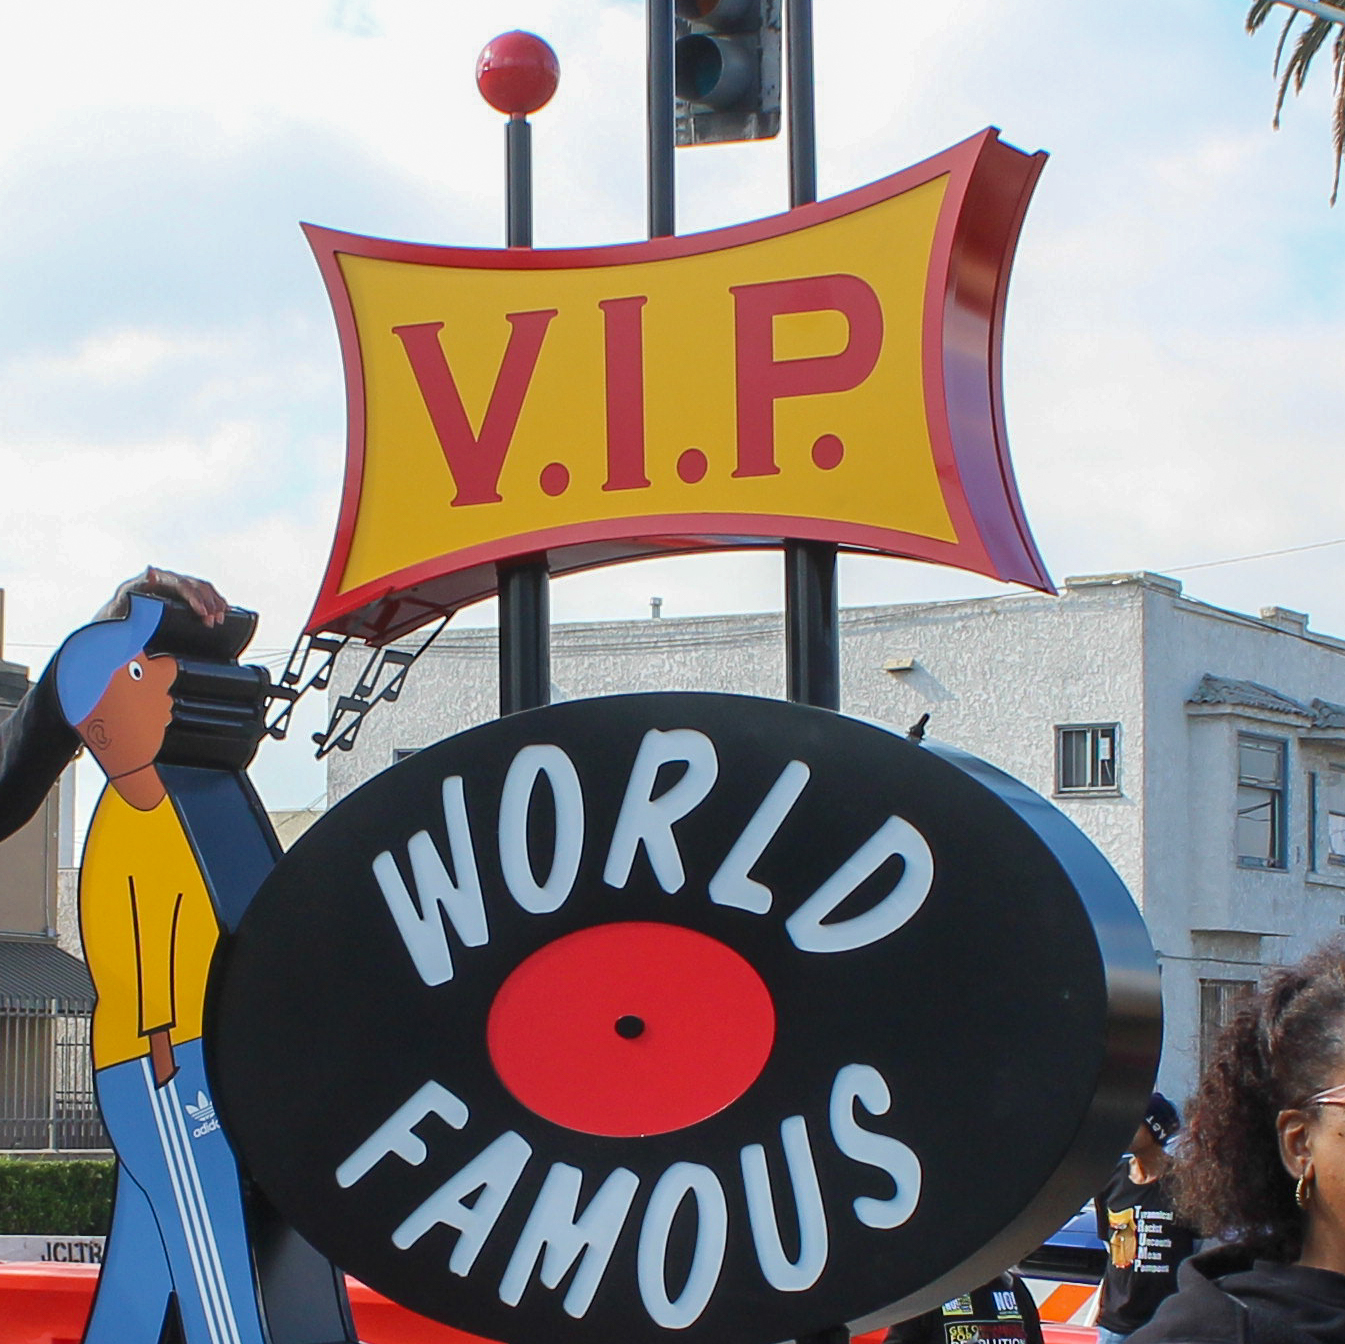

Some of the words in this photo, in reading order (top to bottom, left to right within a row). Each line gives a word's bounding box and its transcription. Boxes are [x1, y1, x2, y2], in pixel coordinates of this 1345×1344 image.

[392, 273, 884, 507] V.I.P.
[371, 727, 935, 987] WORLD
[336, 1063, 923, 1331] FAMOUS
